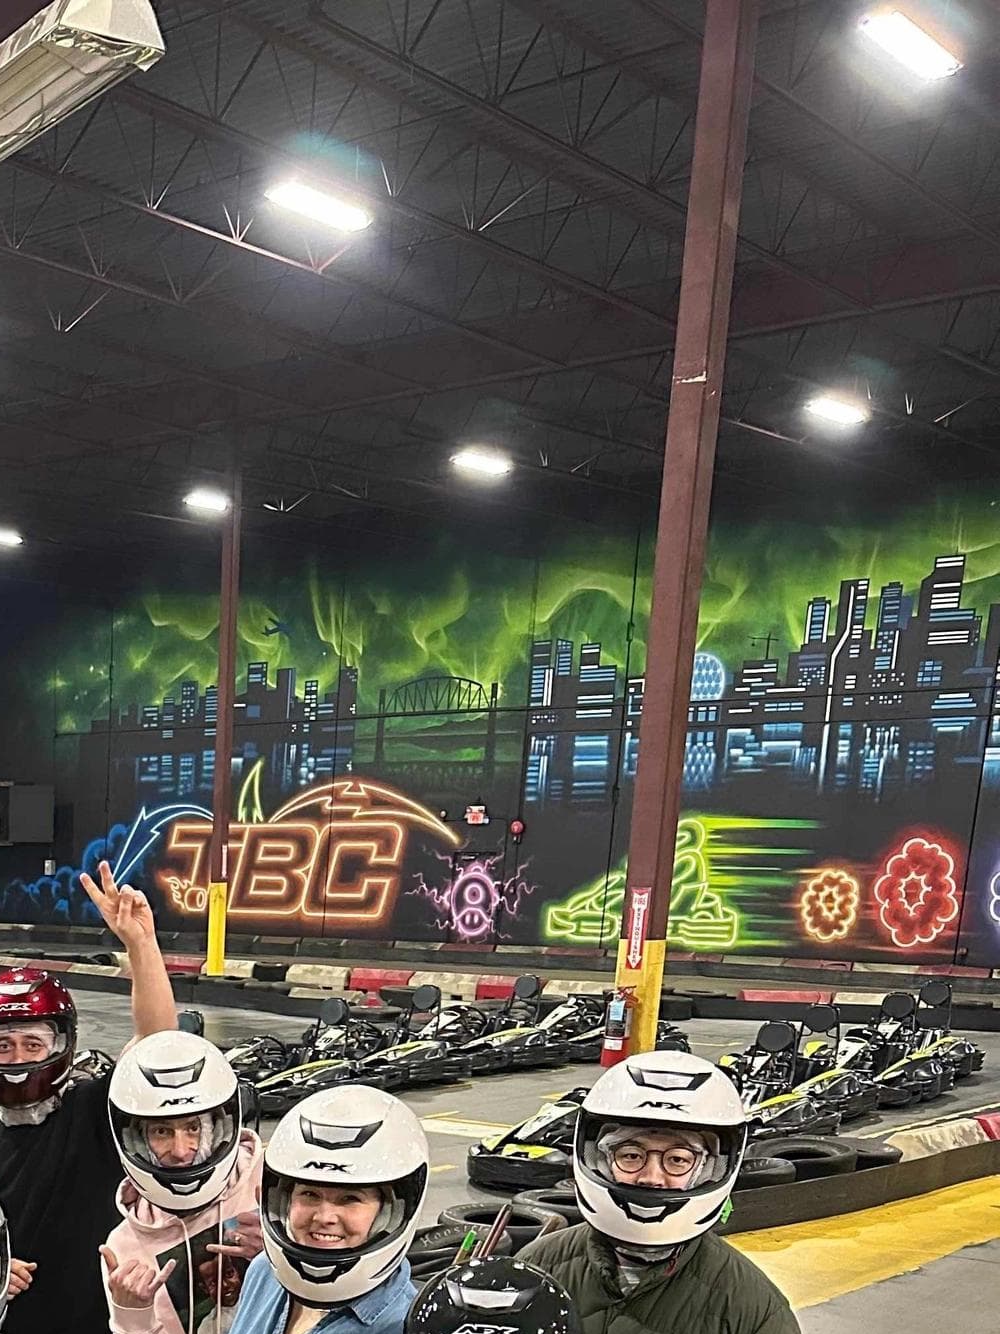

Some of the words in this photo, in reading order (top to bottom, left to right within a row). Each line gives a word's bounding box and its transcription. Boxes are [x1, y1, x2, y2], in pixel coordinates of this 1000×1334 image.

[169, 818, 404, 919] TBC
[635, 1101, 689, 1113] AFX
[303, 1161, 352, 1174] AFX
